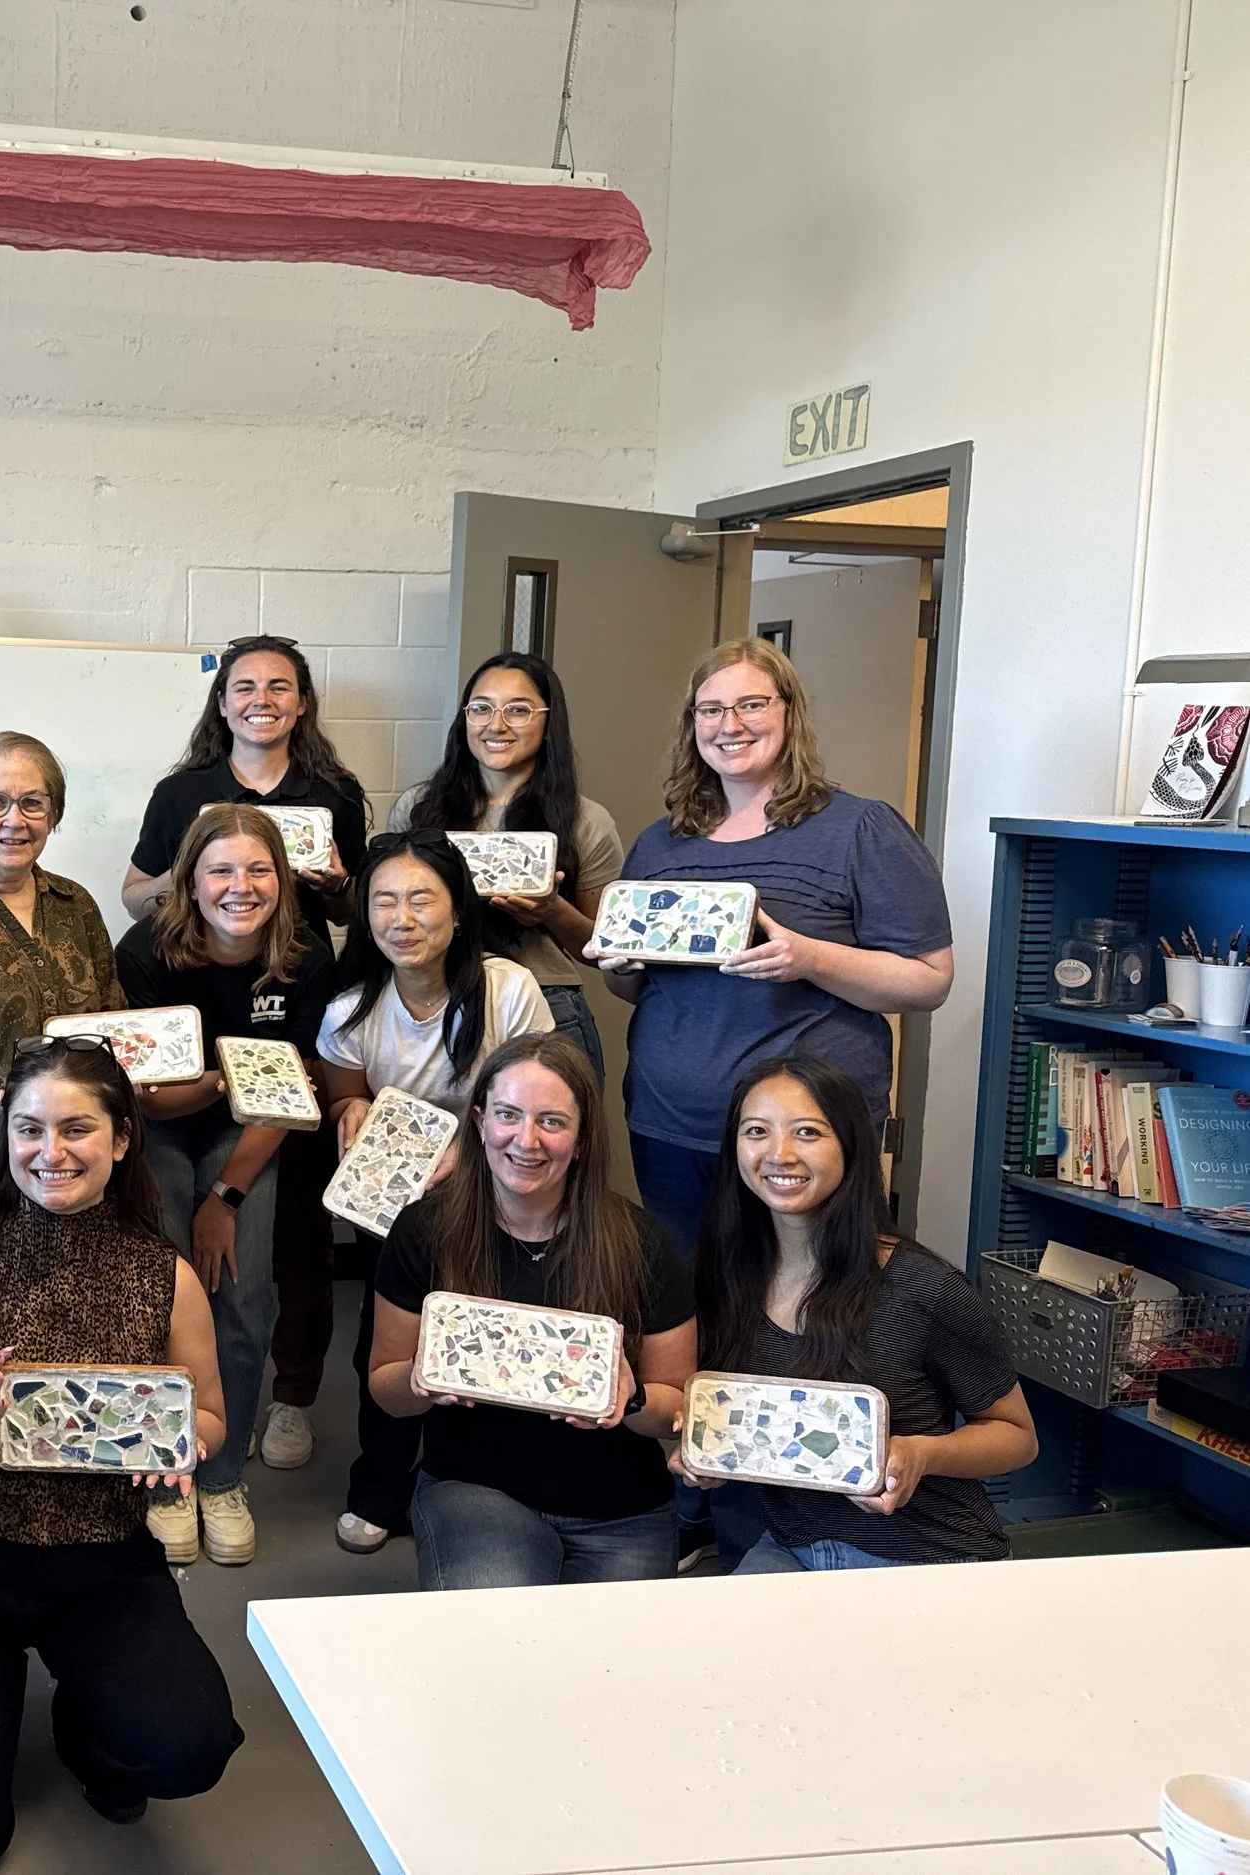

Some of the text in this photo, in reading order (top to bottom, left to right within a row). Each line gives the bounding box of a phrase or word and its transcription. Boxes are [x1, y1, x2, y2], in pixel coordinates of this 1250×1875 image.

[790, 385, 869, 456] EXIT
[252, 995, 285, 1012] WT
[1138, 1117, 1149, 1165] WORKING
[1190, 1161, 1229, 1173] YOUR
